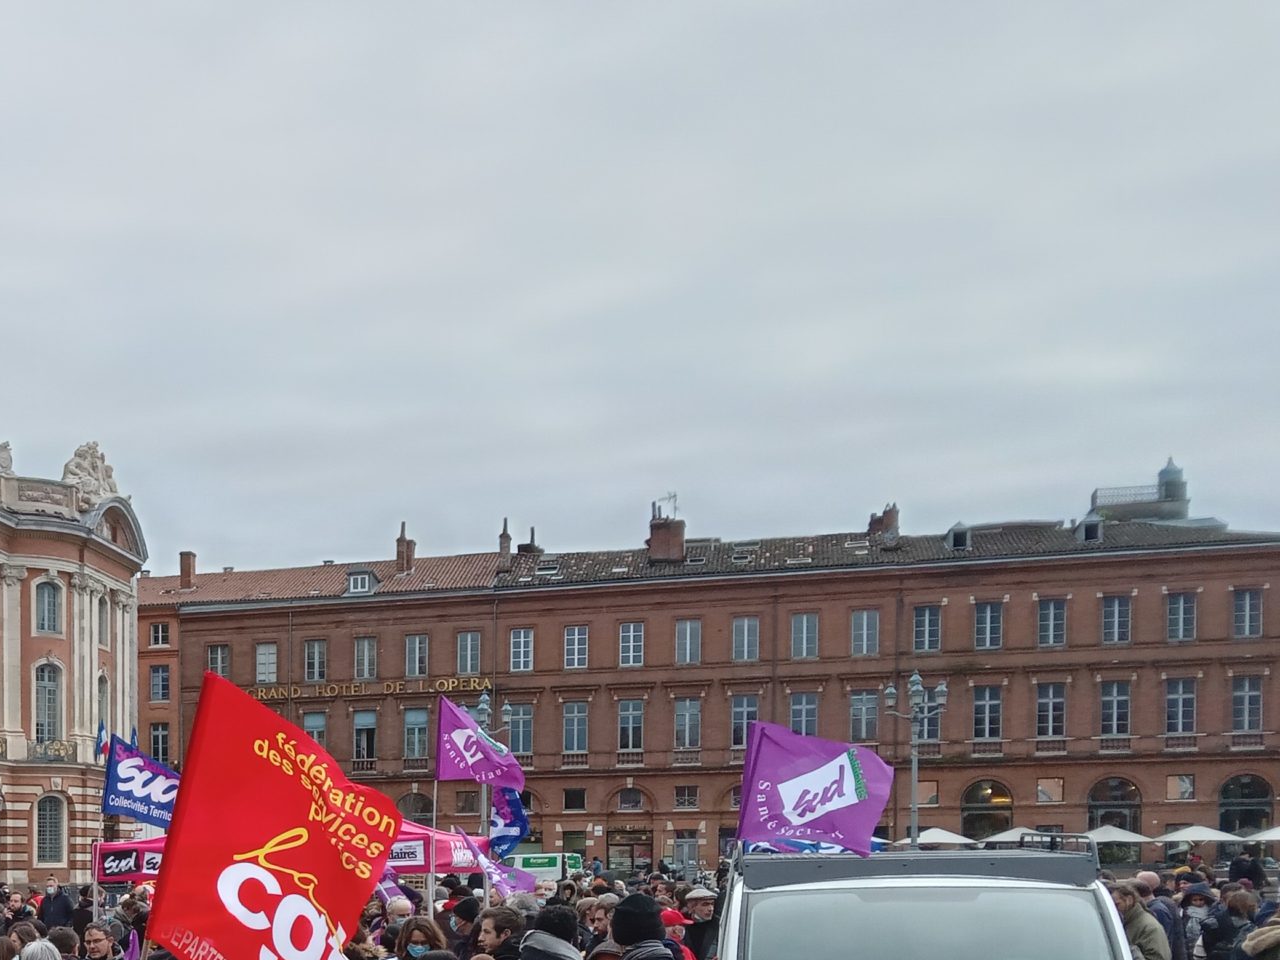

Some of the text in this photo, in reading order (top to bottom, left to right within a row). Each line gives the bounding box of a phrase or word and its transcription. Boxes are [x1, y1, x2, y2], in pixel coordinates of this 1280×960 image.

[384, 680, 405, 694] DE
[253, 739, 294, 776] des
[275, 732, 396, 838] fédération
[104, 851, 136, 874] Sud
